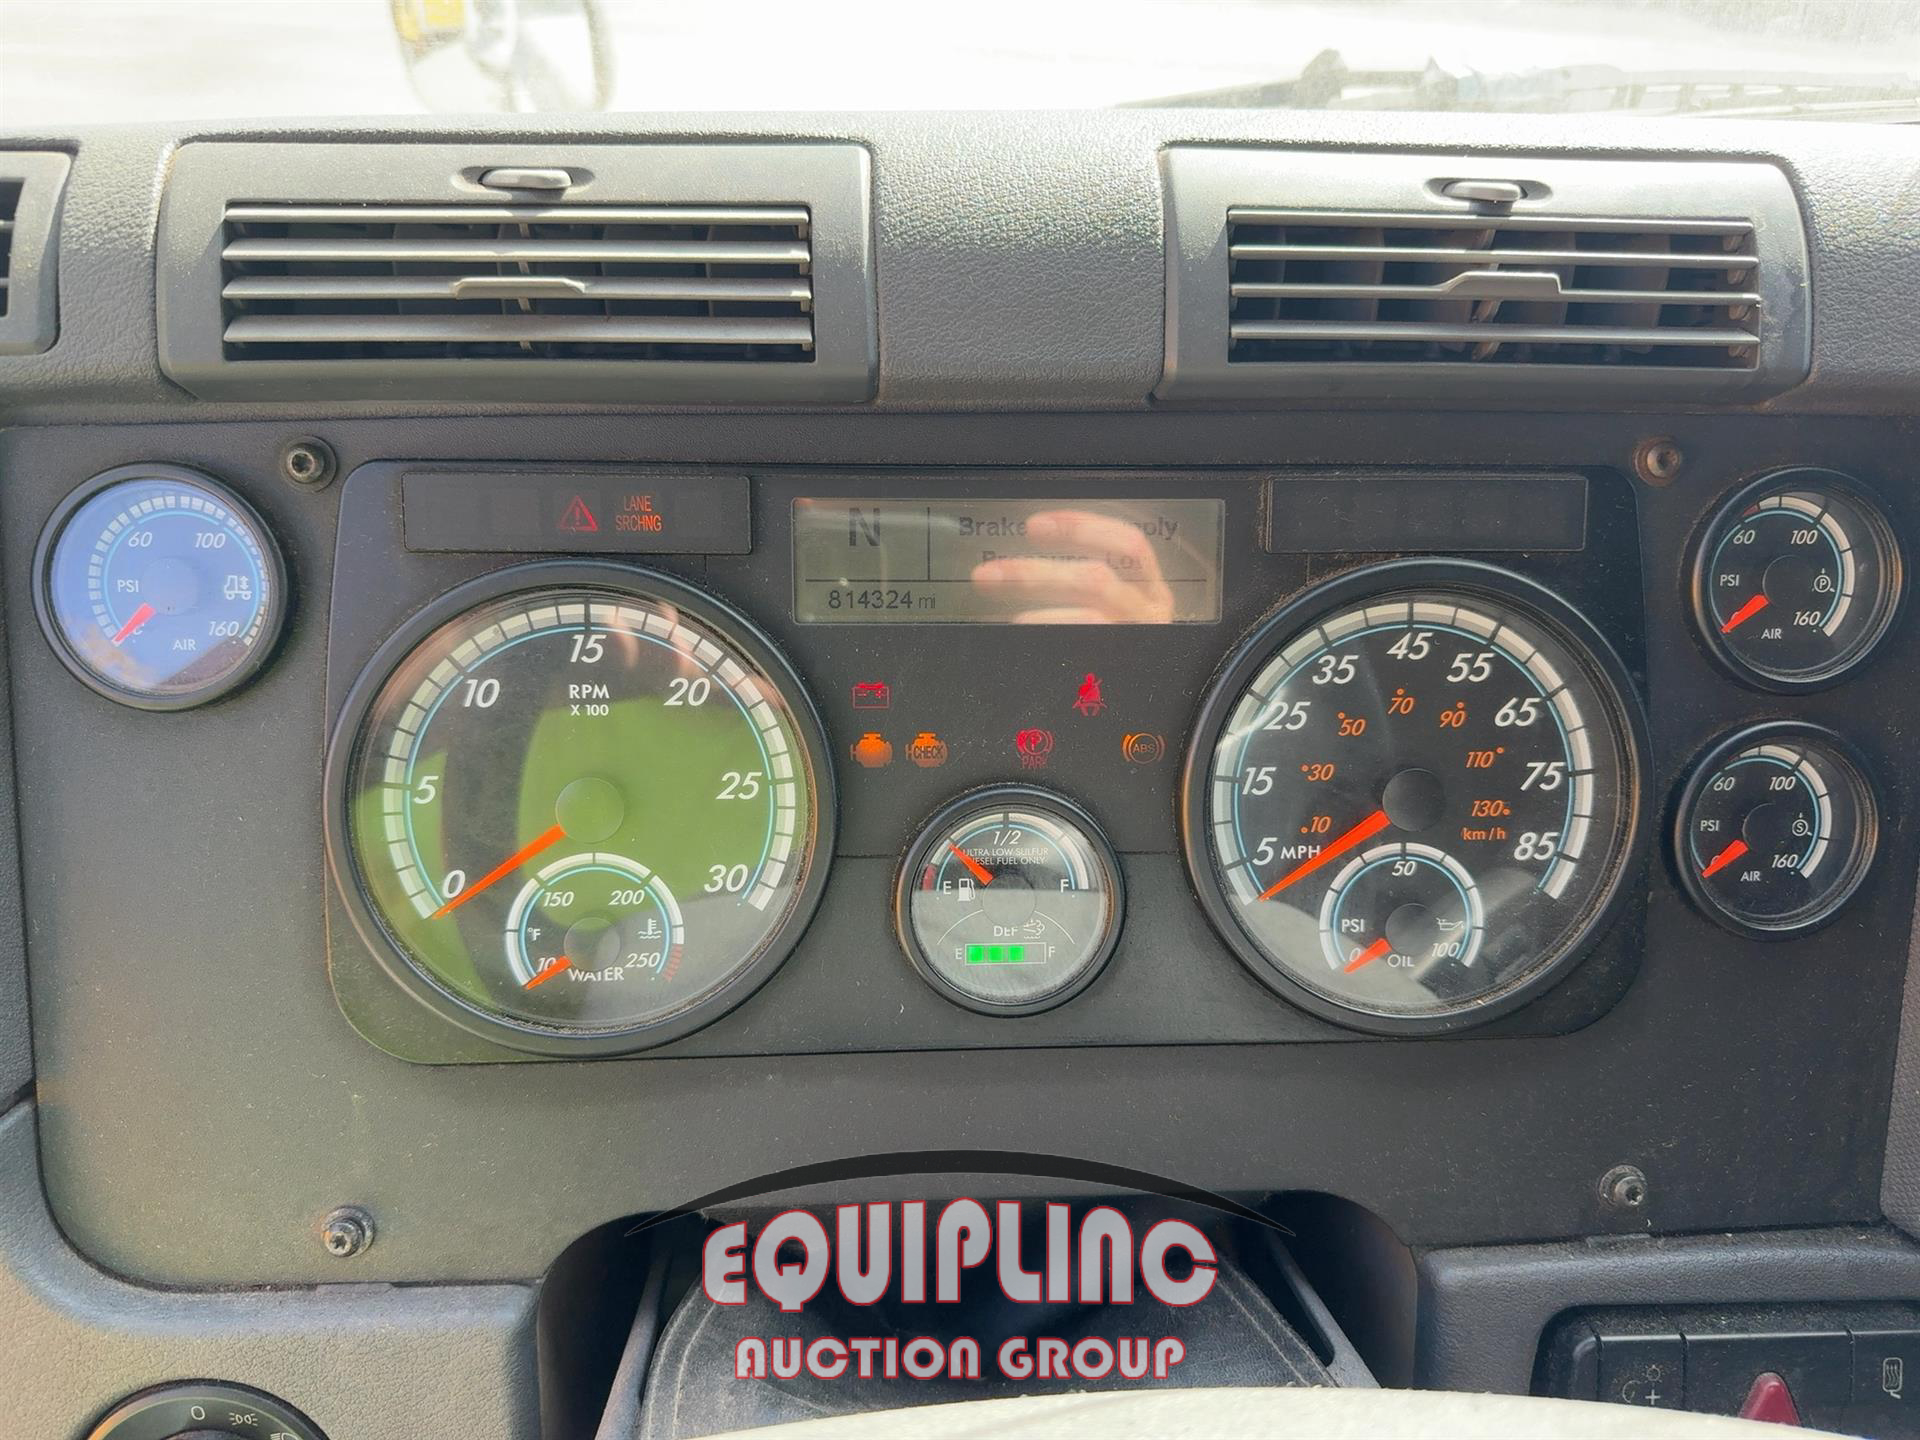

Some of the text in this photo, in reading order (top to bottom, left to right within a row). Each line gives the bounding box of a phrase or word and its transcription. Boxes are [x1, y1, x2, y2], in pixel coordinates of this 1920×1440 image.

[623, 495, 652, 512] LANE
[615, 515, 663, 532] SRCHNG
[848, 507, 880, 547] N
[959, 517, 1028, 536] Brake
[128, 531, 153, 549] 60
[194, 532, 226, 549] 100
[1732, 529, 1756, 545] 60
[1790, 529, 1818, 545] 100
[117, 580, 140, 593] PSI
[1719, 574, 1740, 587] PSI
[828, 590, 936, 609] 814324 mi
[1793, 611, 1821, 626] 160
[208, 621, 240, 637] 160
[1760, 628, 1782, 640] AIR
[172, 639, 197, 651] AIR
[569, 634, 607, 664] 15
[1386, 632, 1433, 660] 45
[1312, 654, 1358, 684] 35
[1446, 652, 1494, 682] 55
[463, 678, 501, 708] 10
[568, 684, 610, 700] RPM
[664, 677, 711, 707] 20
[582, 704, 609, 717] 100
[1387, 697, 1415, 716] 70
[1494, 697, 1540, 727] 65
[1263, 700, 1311, 731] 25
[1439, 710, 1466, 728] 90
[1338, 718, 1366, 736] 50
[913, 745, 944, 759] CHECK
[1132, 743, 1155, 754] ABS
[1466, 751, 1494, 769] 110
[1241, 766, 1276, 795] 15
[1307, 763, 1334, 781] 30
[1520, 761, 1565, 791] 75
[413, 775, 439, 804] 5
[716, 771, 762, 801] 25
[1713, 776, 1735, 792] 60
[1769, 776, 1796, 791] 100
[1471, 800, 1503, 817] 130
[1311, 815, 1331, 834] 10
[1700, 819, 1720, 832] PSI
[993, 830, 1022, 846] 1/2
[1513, 831, 1558, 861] 85
[962, 848, 989, 857] ULTRA
[992, 848, 1013, 857] LOW
[1252, 837, 1277, 865] 5
[1280, 845, 1321, 860] MPH
[972, 857, 994, 865] IESEL
[996, 856, 1017, 865] FUEL
[1391, 861, 1416, 876] 50
[1771, 853, 1799, 868] 160
[441, 869, 465, 899] 0
[703, 864, 748, 894] 30
[1740, 871, 1761, 882] AIR
[943, 881, 952, 894] E
[1060, 878, 1069, 893] F
[543, 891, 575, 907] 150
[608, 890, 645, 906] 200
[1341, 918, 1365, 933] PSI
[1431, 942, 1459, 958] 100
[624, 952, 662, 969] 250
[1387, 953, 1415, 968] OIL
[567, 966, 625, 982] WATER
